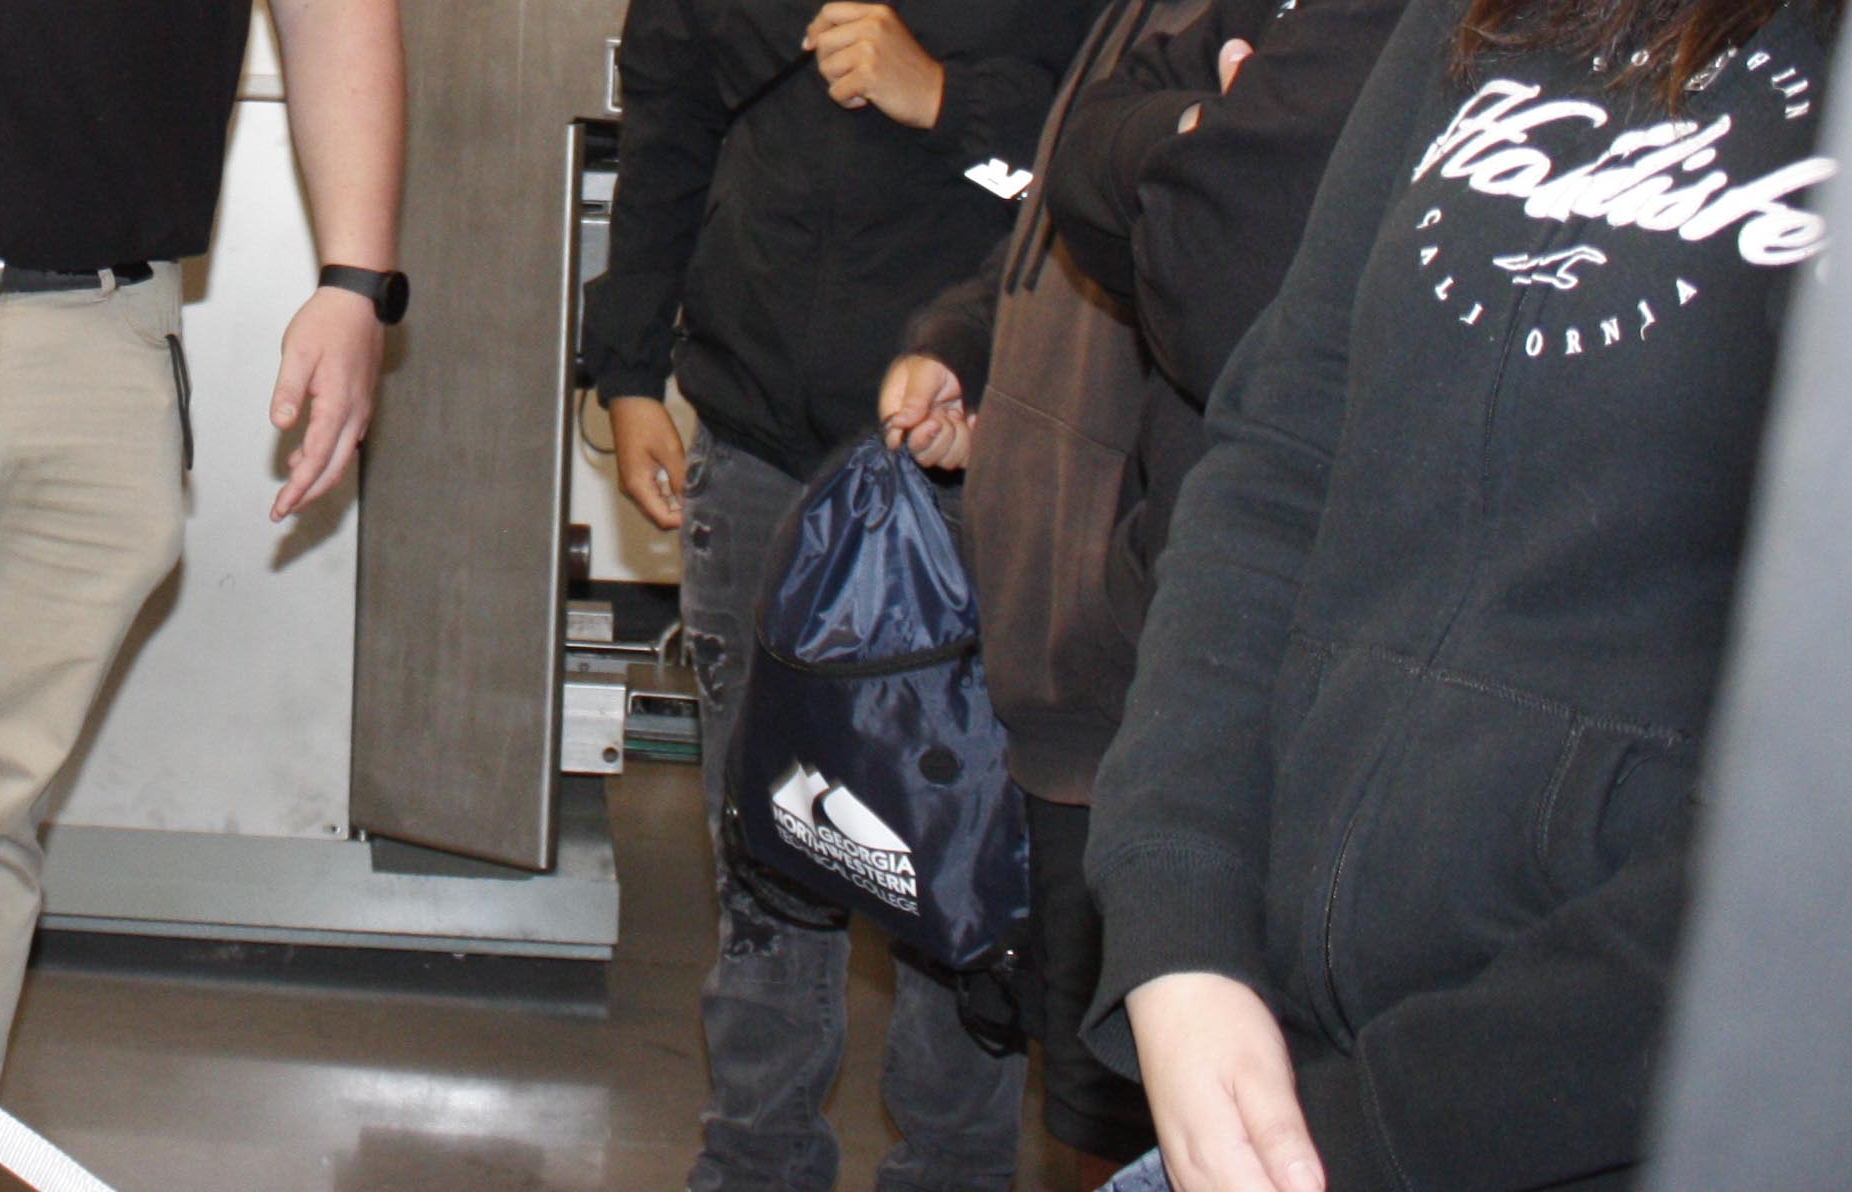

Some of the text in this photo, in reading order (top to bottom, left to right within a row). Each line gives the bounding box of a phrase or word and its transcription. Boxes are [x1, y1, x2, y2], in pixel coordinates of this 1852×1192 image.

[1412, 80, 1840, 266] Holliste
[1416, 208, 1699, 357] CALIORNIA
[773, 806, 918, 899] NORTHWESTERN
[818, 825, 916, 877] GEORGIA
